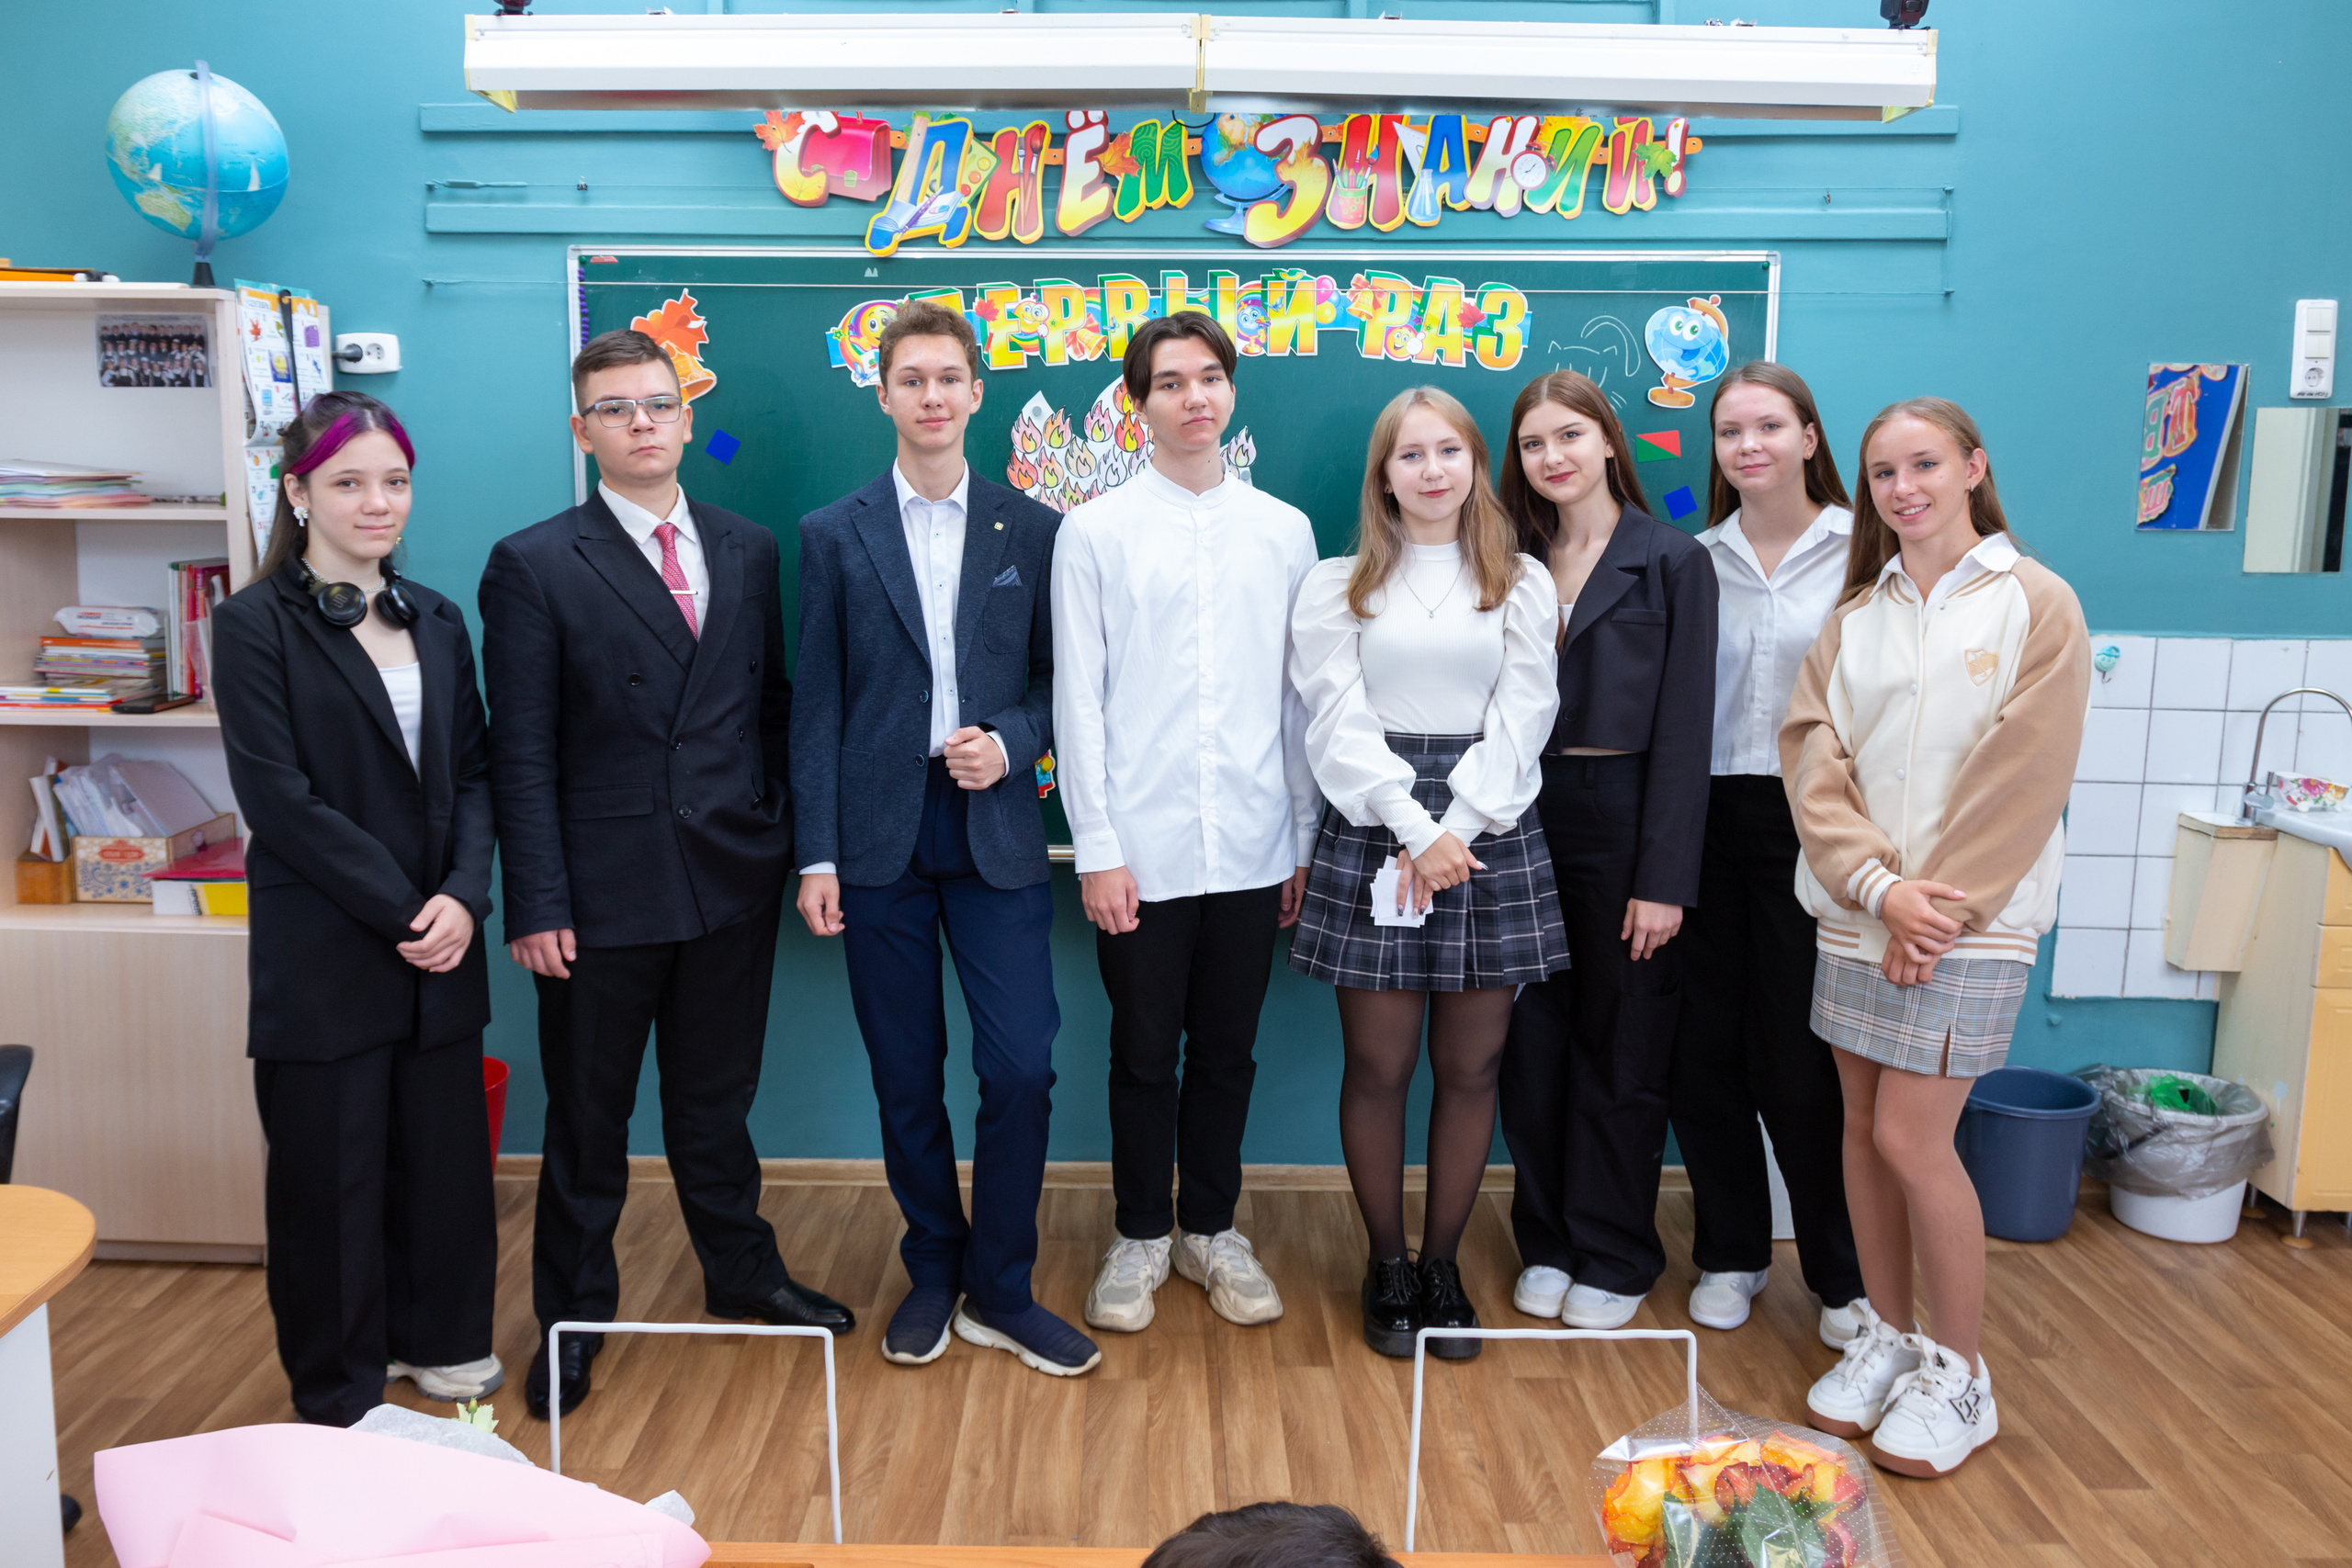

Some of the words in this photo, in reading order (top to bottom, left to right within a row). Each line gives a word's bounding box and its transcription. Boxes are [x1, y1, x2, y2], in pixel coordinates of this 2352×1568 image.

[774, 110, 841, 208] С
[865, 111, 1193, 257] ДНЁМ
[1243, 112, 1690, 248] ЗНАНИЙ!
[1355, 268, 1529, 372] РАЗ
